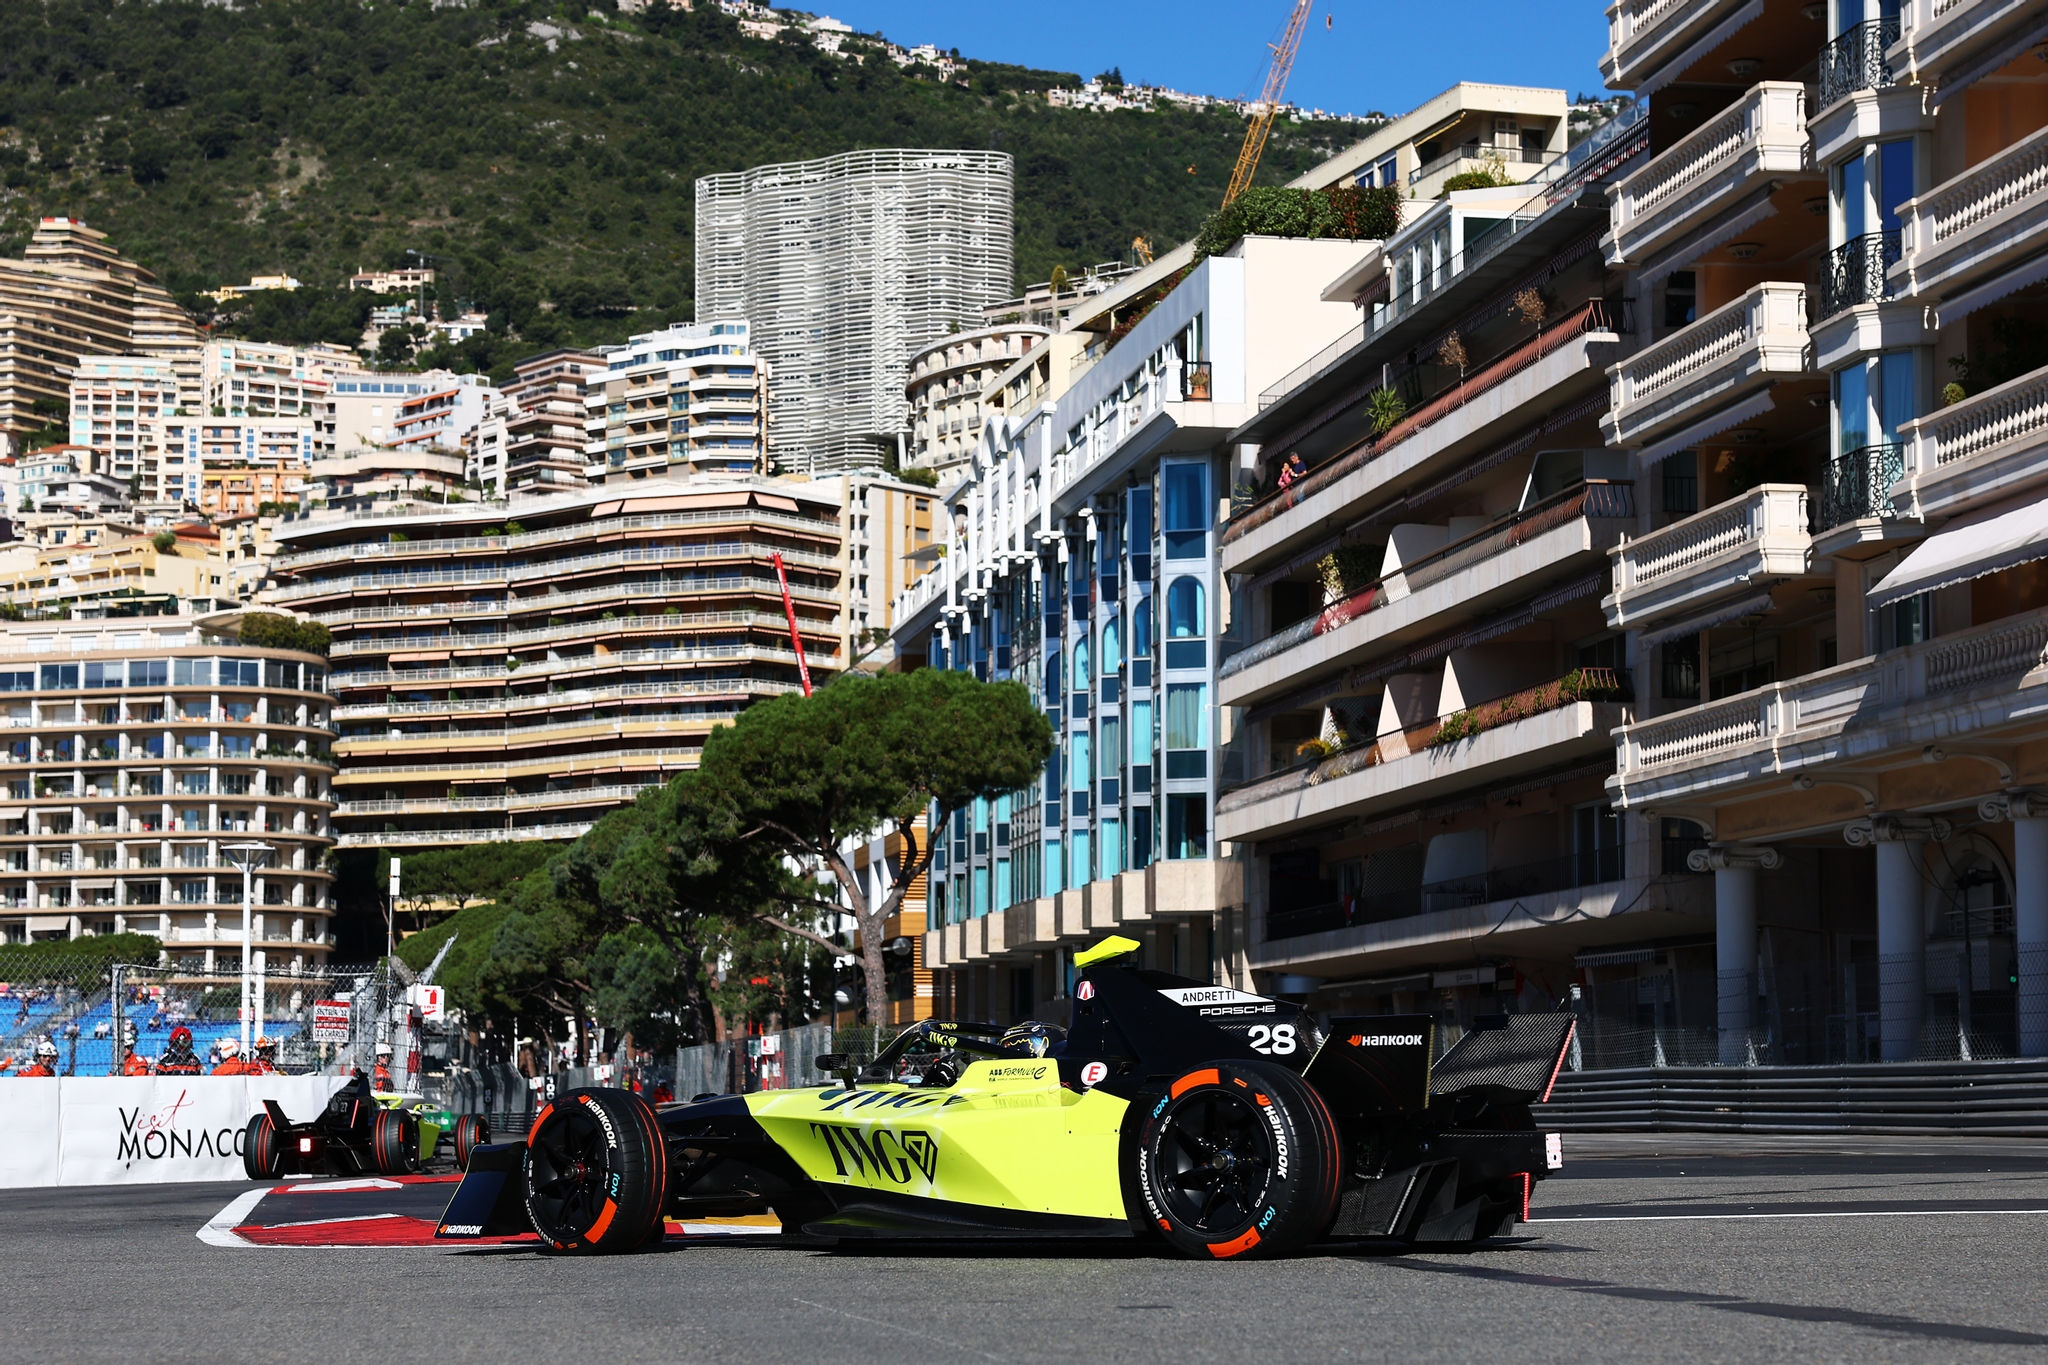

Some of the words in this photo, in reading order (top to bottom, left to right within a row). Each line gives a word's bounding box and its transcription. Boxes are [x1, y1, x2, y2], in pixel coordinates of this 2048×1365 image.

[1182, 990, 1235, 1002] ANDRETTI
[1200, 1005, 1276, 1016] PORSCHE
[1247, 1024, 1296, 1055] 28
[1361, 1035, 1422, 1046] HANKOOK
[1002, 1067, 1036, 1076] FORMULA
[1087, 1066, 1100, 1081] E
[118, 1089, 194, 1140] Visit
[809, 1122, 912, 1184] TWG
[444, 1224, 483, 1235] HANKOOK
